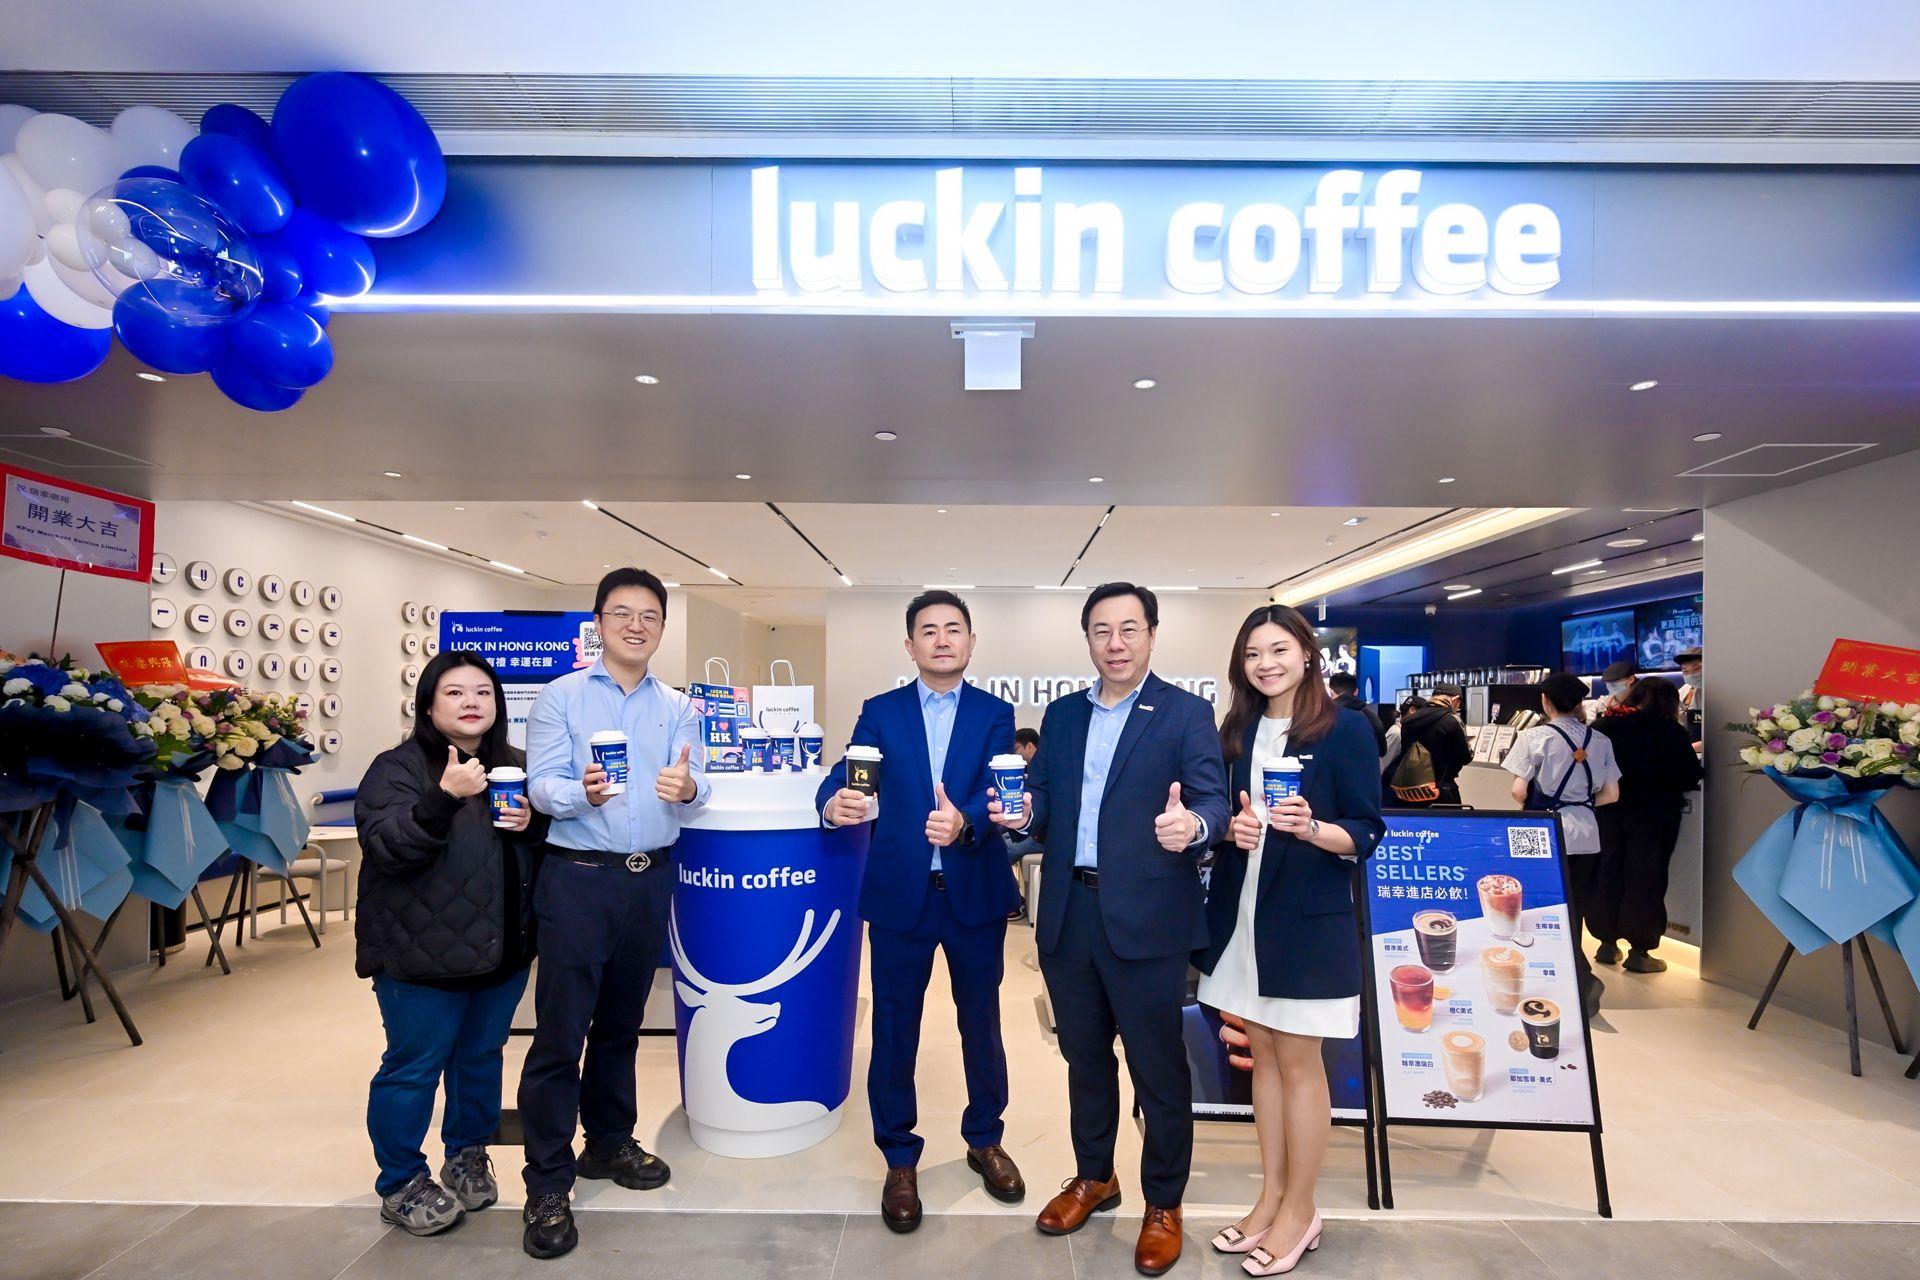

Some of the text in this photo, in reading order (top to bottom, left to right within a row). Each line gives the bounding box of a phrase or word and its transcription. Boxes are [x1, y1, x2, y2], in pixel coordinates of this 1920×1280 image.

[752, 166, 1562, 295] luckin coffee
[28, 503, 119, 538] 開業大吉
[101, 543, 127, 553] Limited
[451, 641, 570, 652] LUCK IN HONG KONG
[990, 679, 1019, 703] IN
[710, 732, 732, 743] HK
[494, 800, 508, 808] HK
[1391, 829, 1440, 839] luckin coffee
[1375, 845, 1425, 861] BEST
[679, 863, 817, 890] luckin coffee
[1375, 864, 1465, 881] SELLERS
[1377, 885, 1468, 900] 瑞幸進店必飲!
